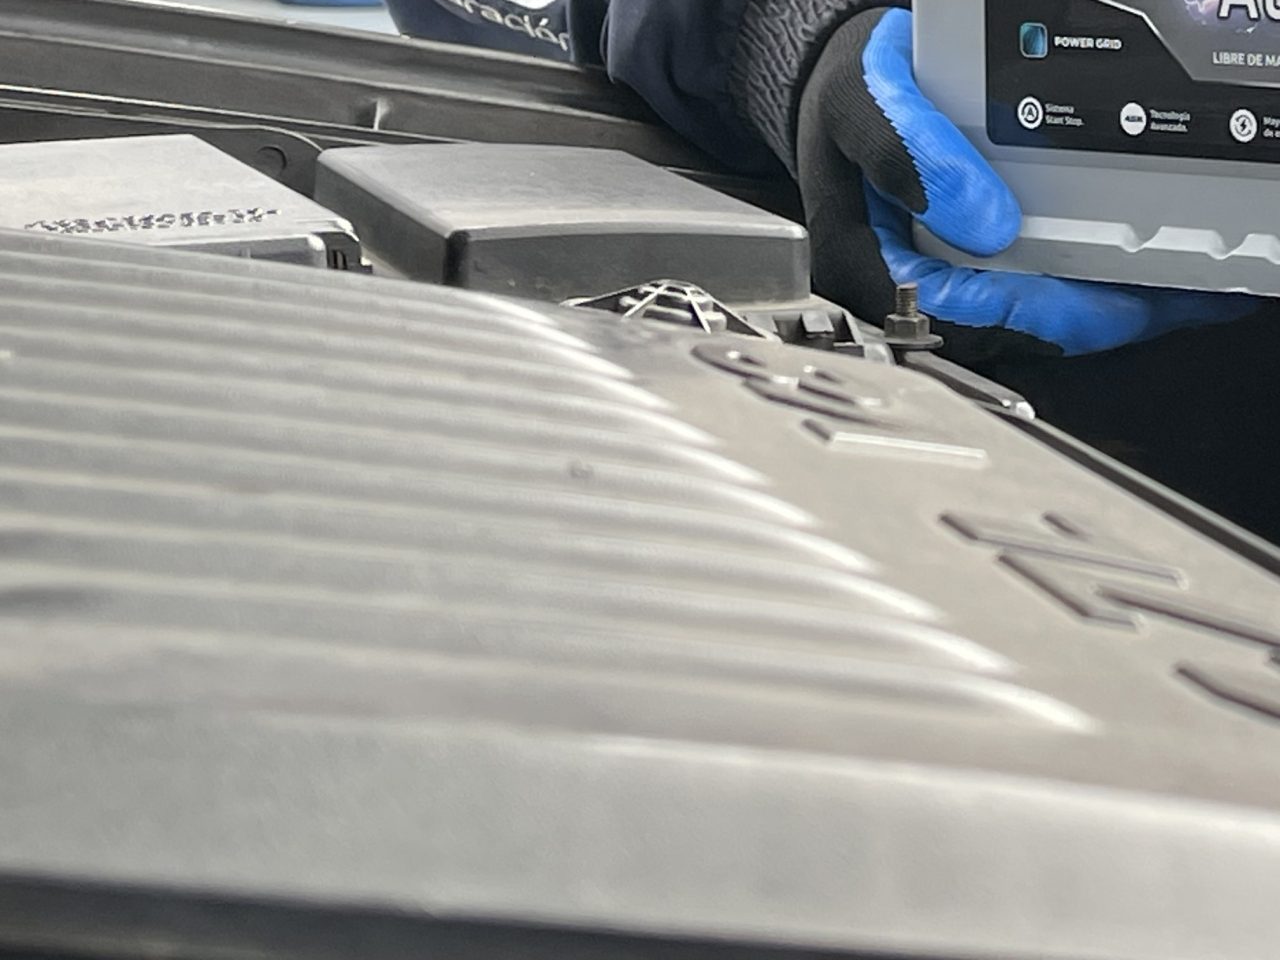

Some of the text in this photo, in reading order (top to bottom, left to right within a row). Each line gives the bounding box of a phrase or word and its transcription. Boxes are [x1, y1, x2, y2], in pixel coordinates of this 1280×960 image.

[1053, 35, 1122, 50] POWER GRID
[1212, 51, 1246, 65] LIBRE
[1246, 53, 1264, 67] DE
[1263, 128, 1274, 138] de
